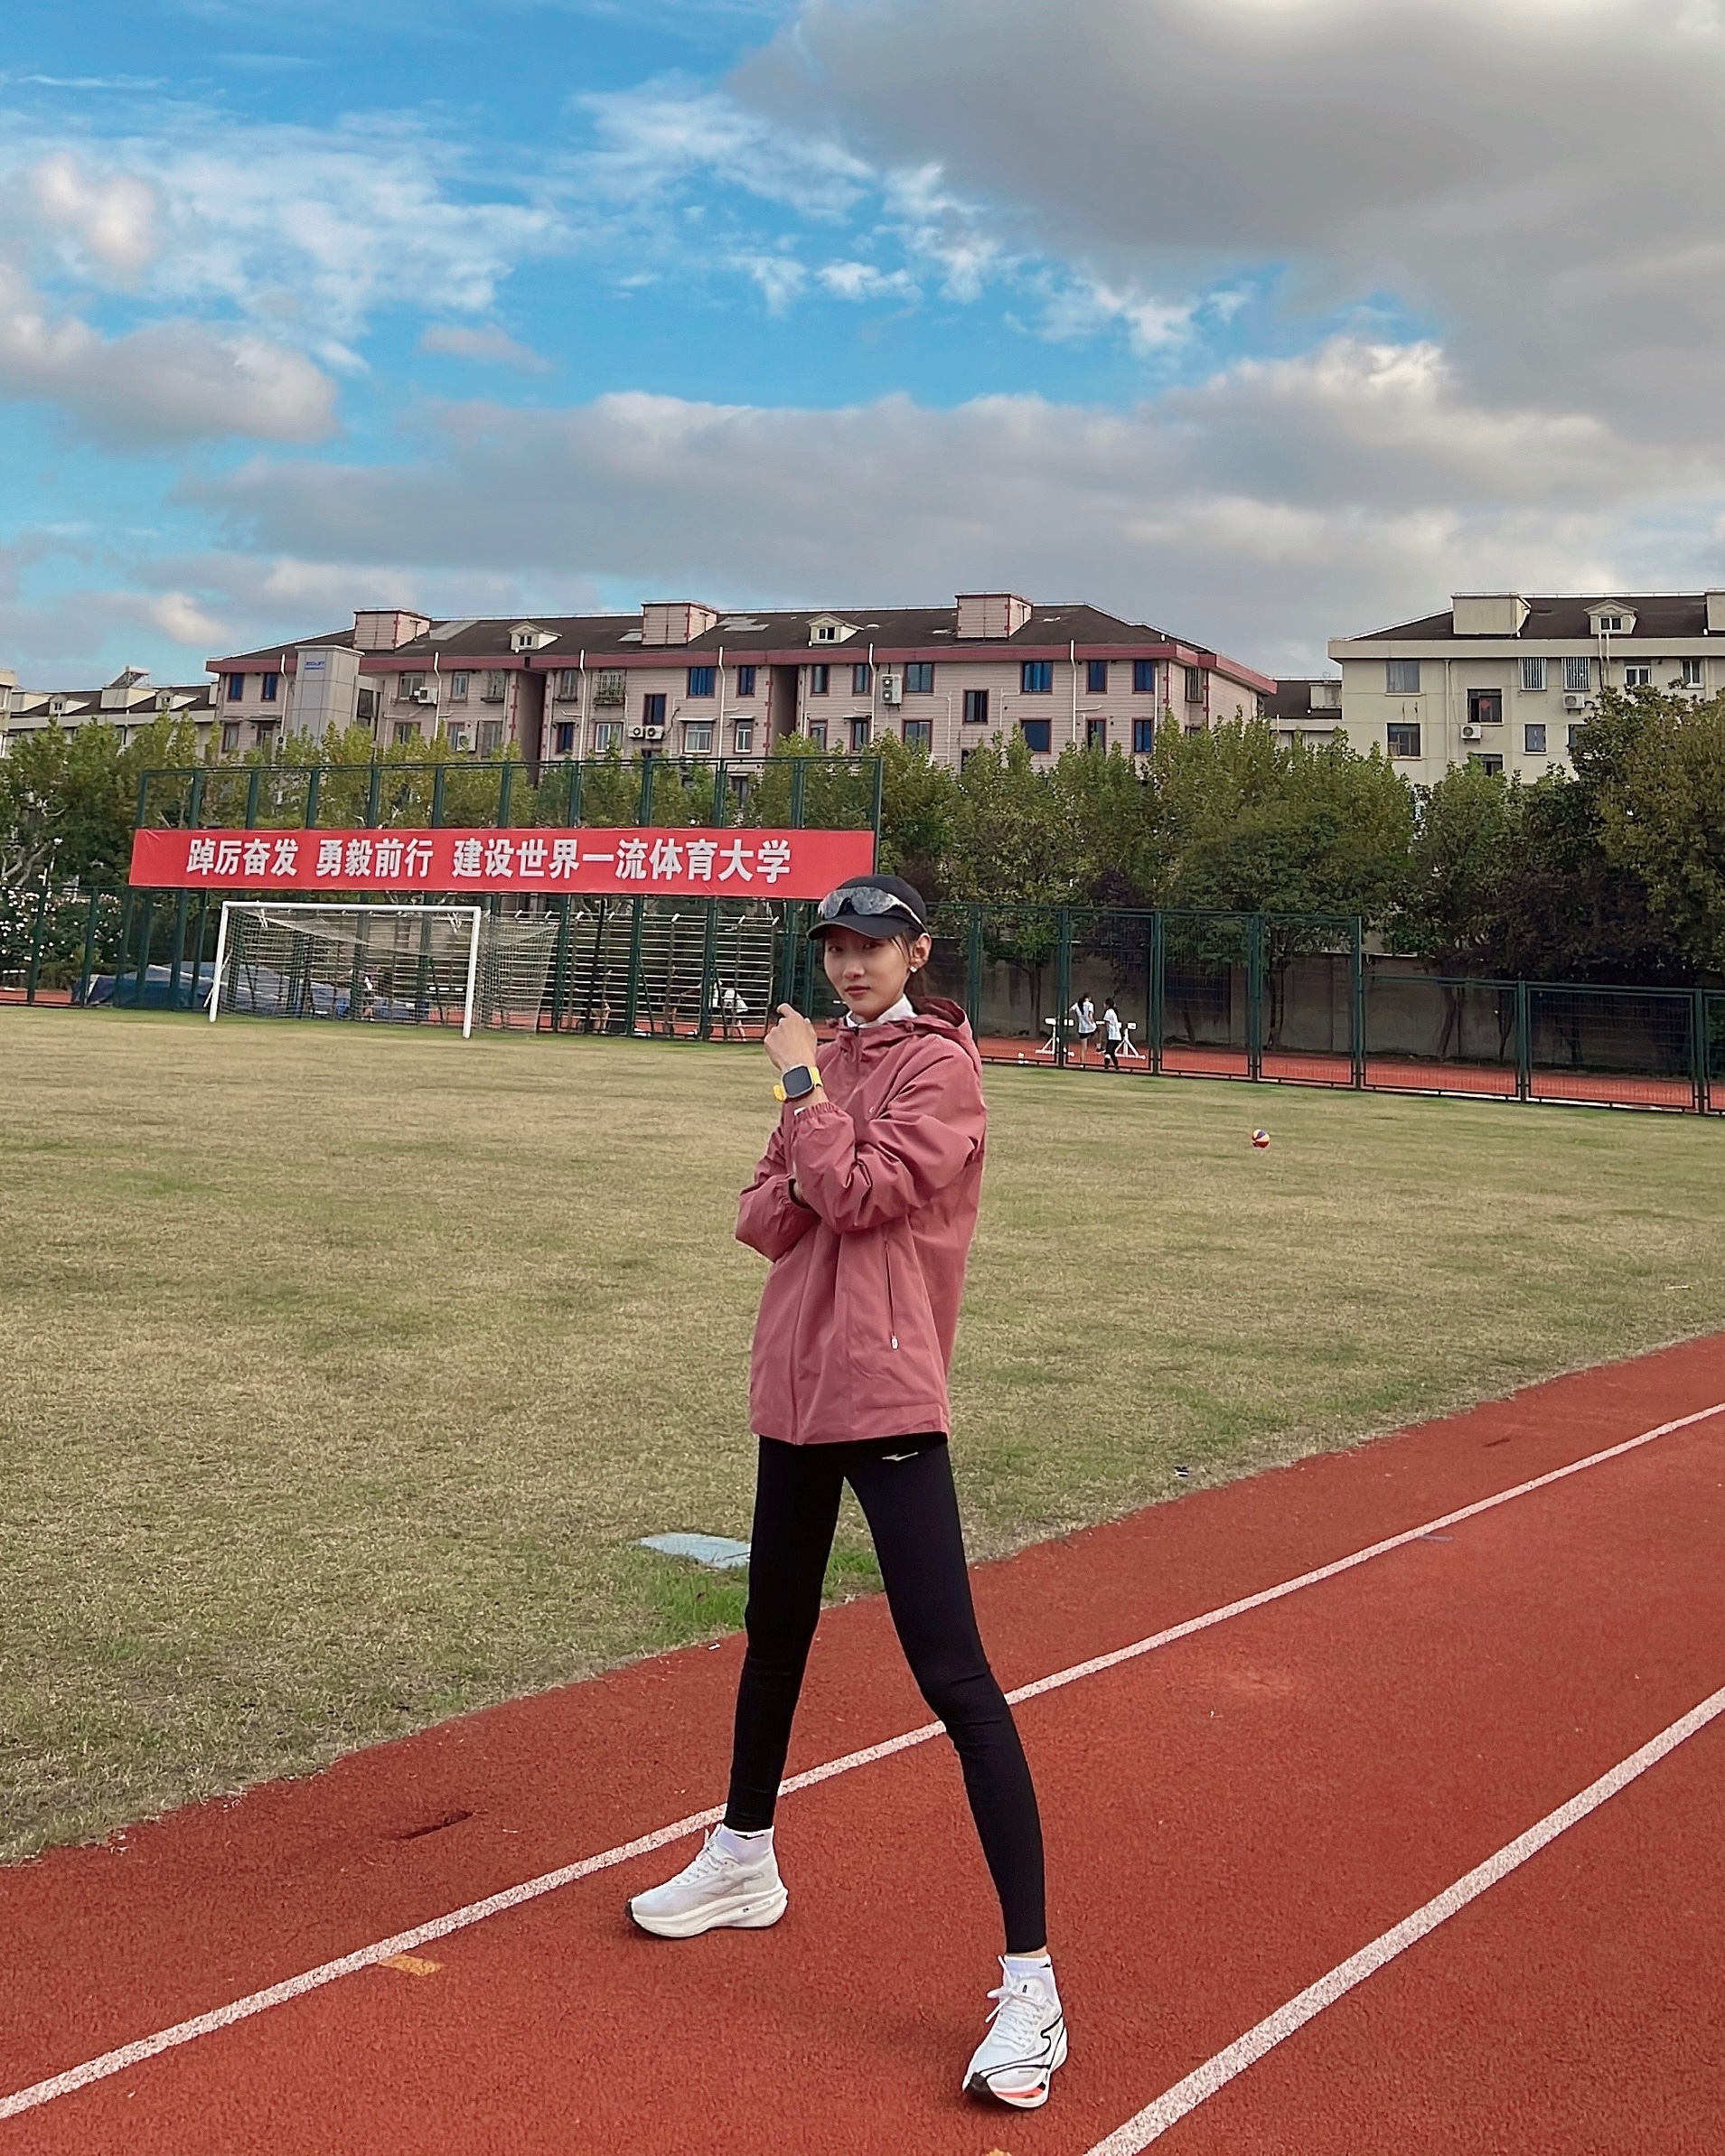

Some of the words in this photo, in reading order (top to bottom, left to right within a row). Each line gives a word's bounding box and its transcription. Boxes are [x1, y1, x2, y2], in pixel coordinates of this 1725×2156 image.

[186, 838, 299, 876] 踔厉奋发
[315, 838, 434, 878] 勇毅前行
[451, 837, 792, 884] 建设世界一流体育大学
